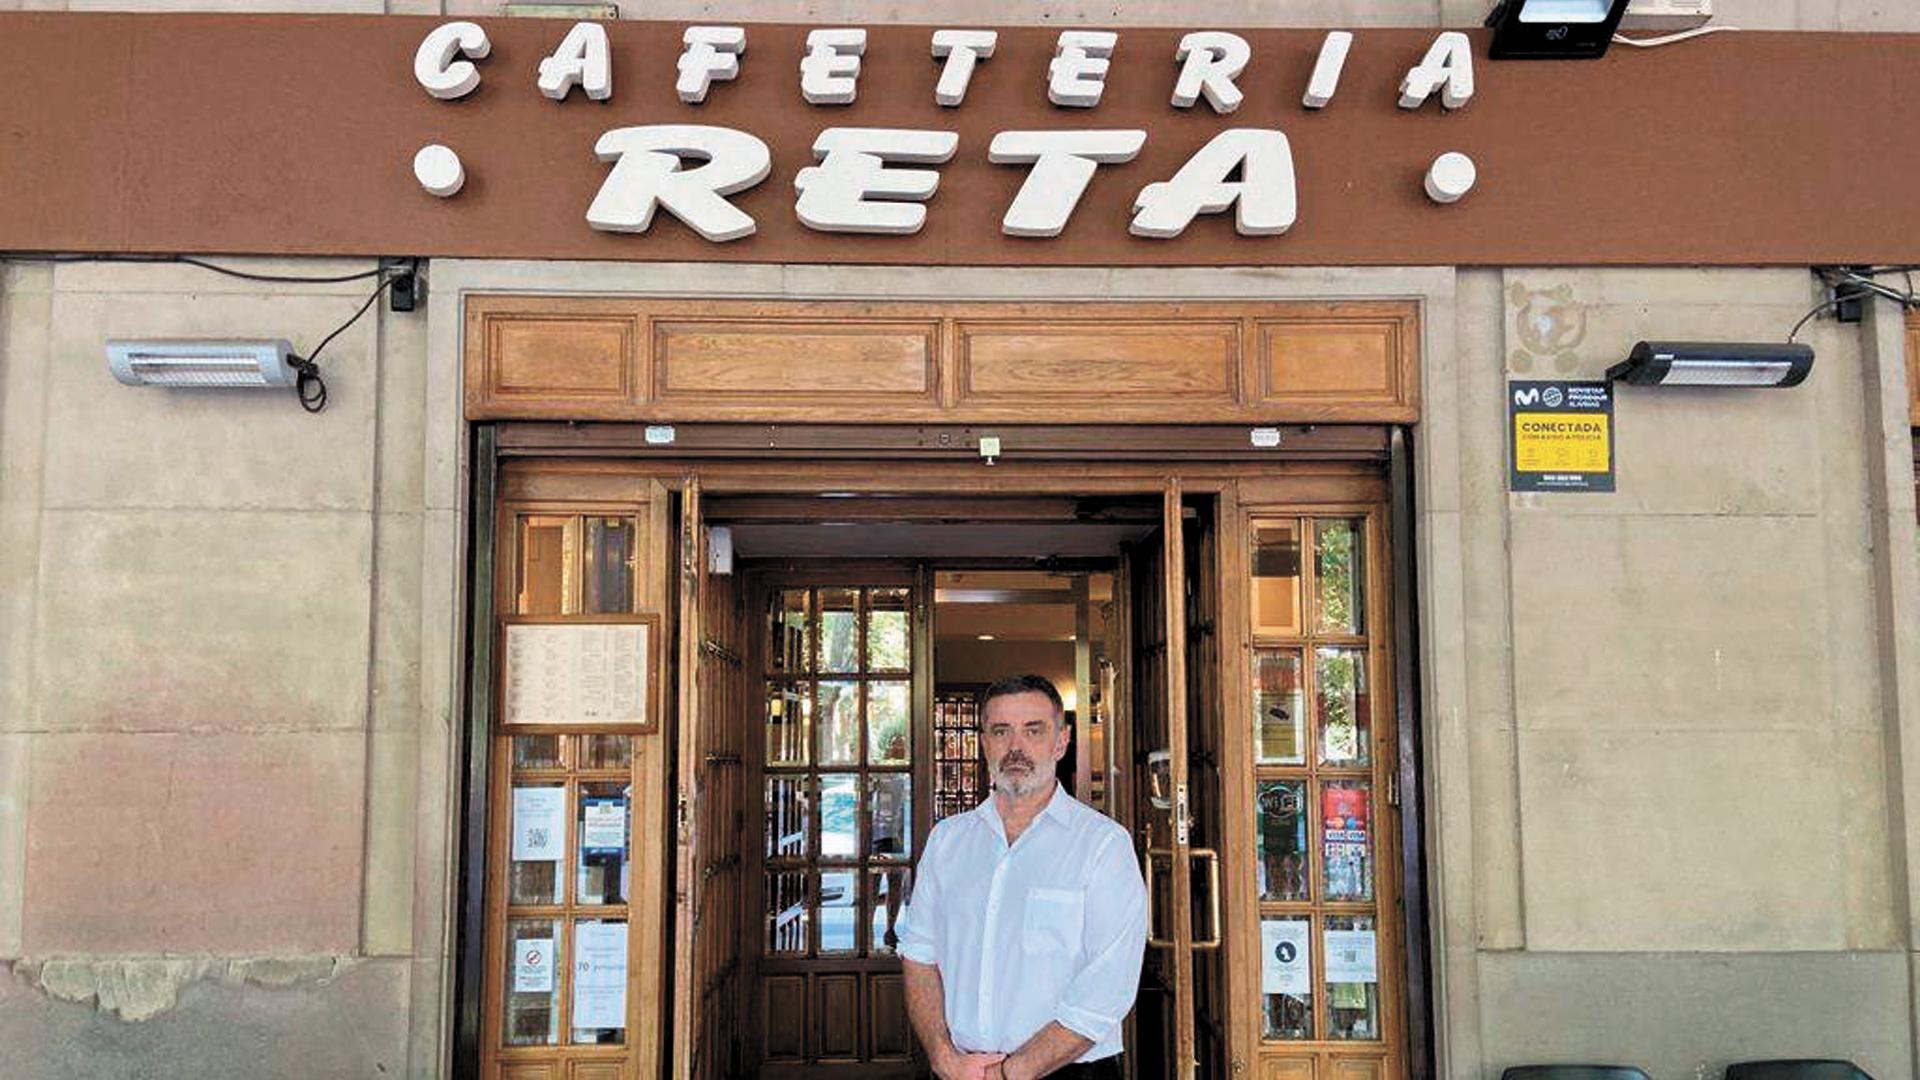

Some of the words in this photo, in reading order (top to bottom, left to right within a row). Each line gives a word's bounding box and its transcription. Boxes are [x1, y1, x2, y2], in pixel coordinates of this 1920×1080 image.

[413, 21, 1476, 115] CAFETERIA
[586, 125, 1297, 242] RETA
[1522, 422, 1602, 433] CONECTADA
